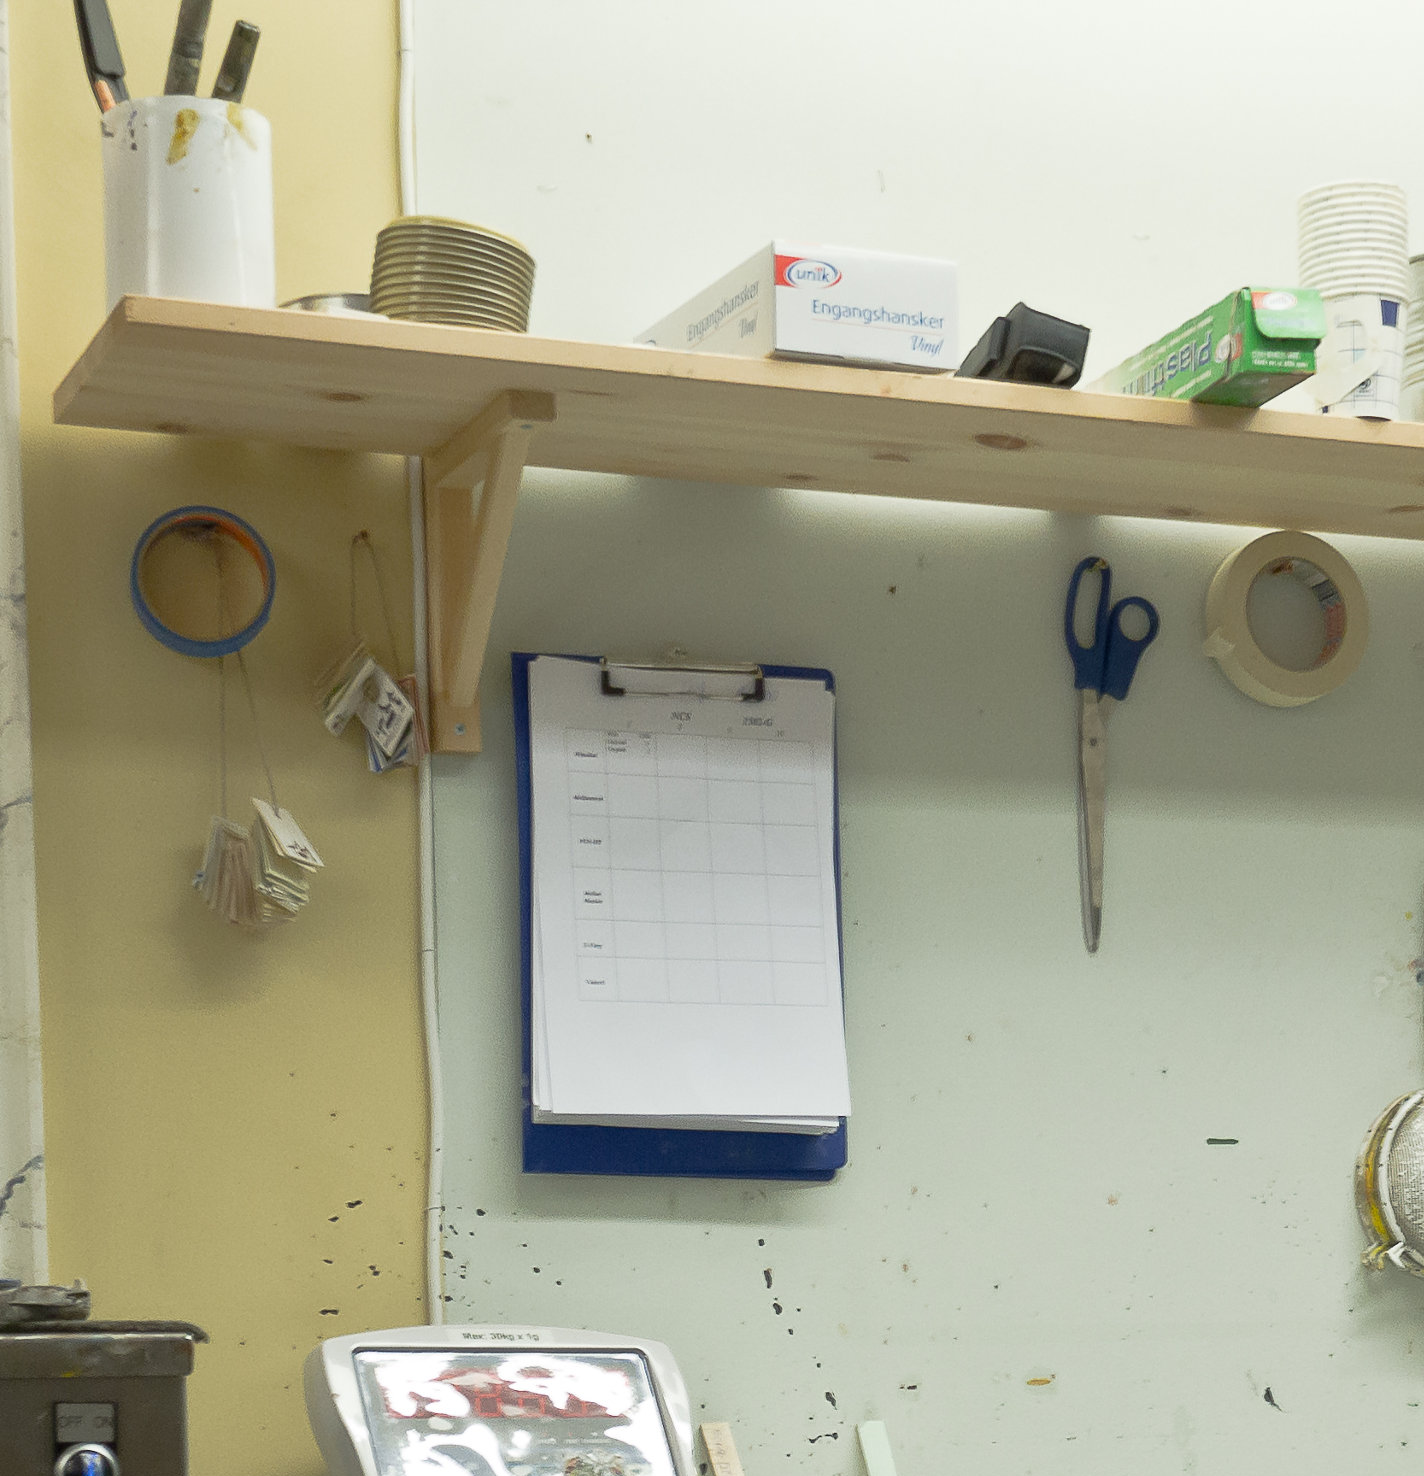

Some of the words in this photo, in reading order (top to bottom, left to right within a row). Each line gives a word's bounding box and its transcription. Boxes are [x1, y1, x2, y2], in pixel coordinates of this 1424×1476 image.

[795, 266, 830, 283] unik
[812, 299, 944, 329] Engangshansker
[911, 335, 944, 357] Vinyl
